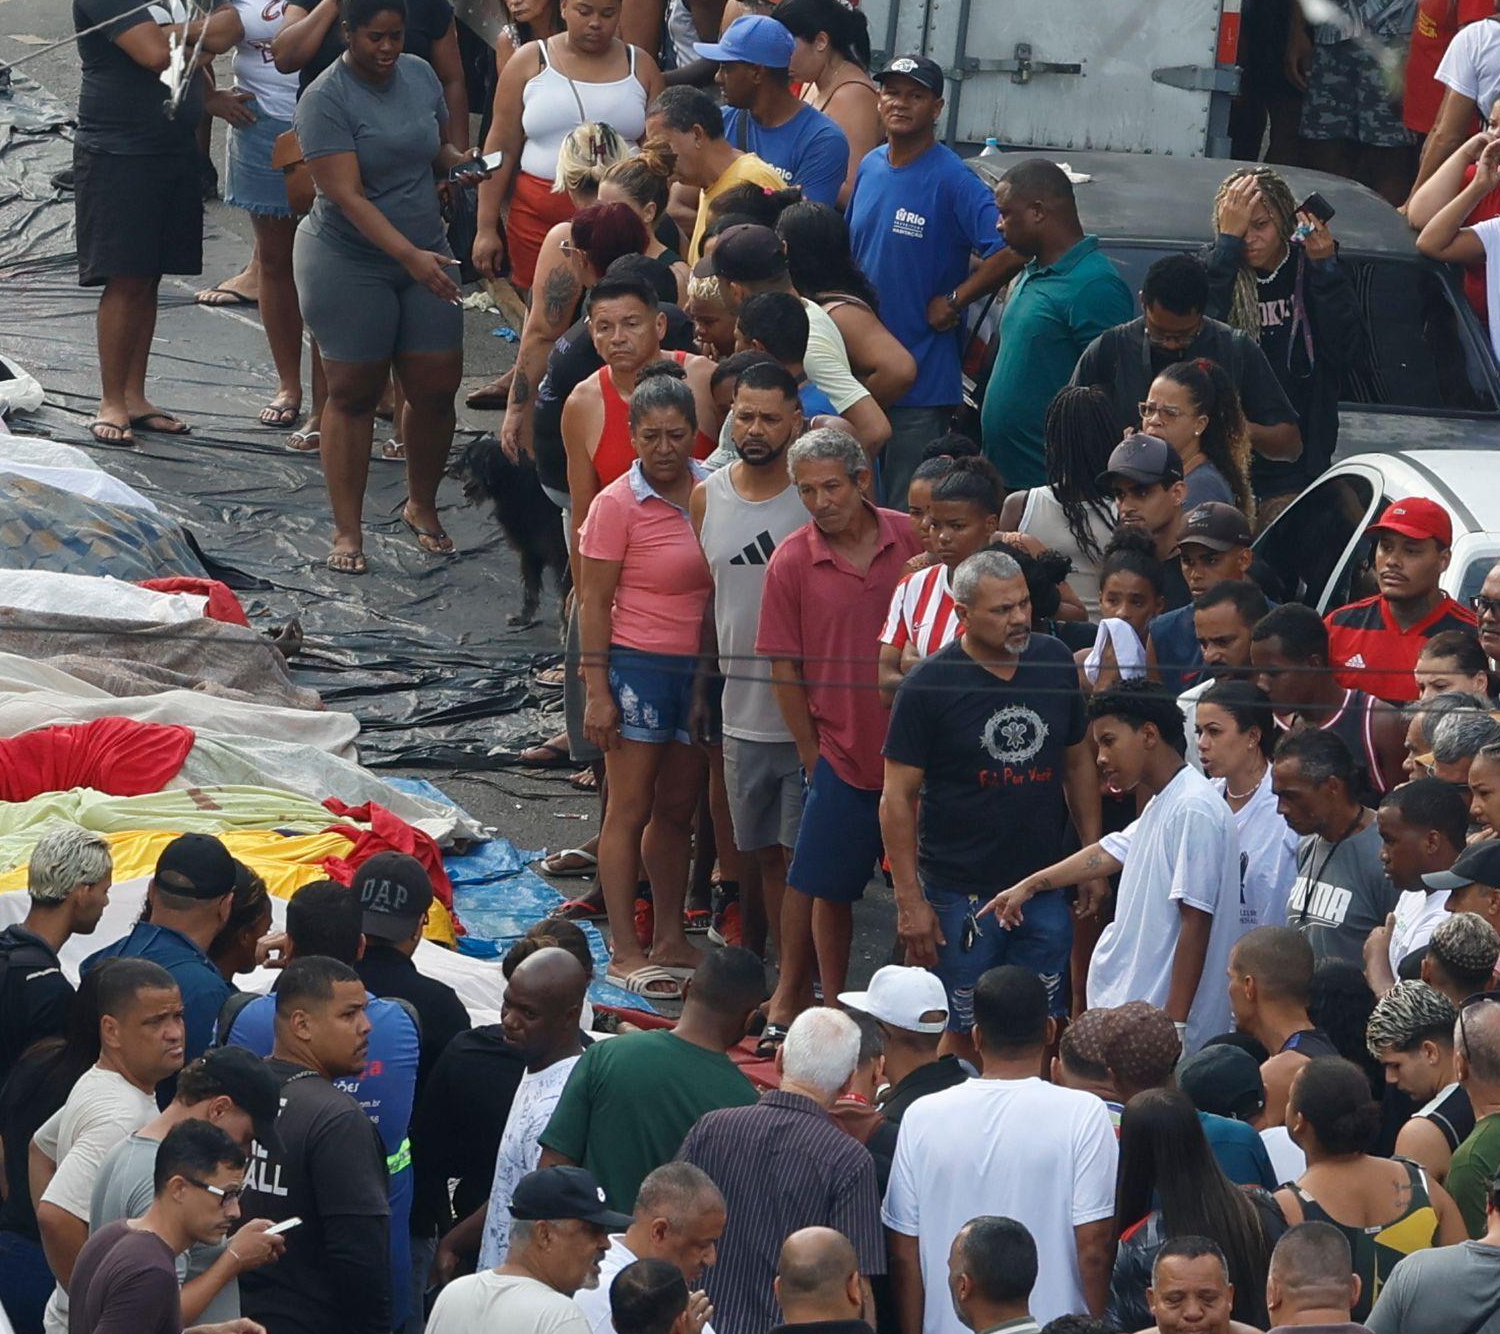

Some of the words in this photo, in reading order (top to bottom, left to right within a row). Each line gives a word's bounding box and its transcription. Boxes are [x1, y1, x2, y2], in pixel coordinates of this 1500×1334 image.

[906, 211, 926, 225] Rio
[1004, 767, 1024, 786] Por
[1291, 877, 1353, 924] PUMA
